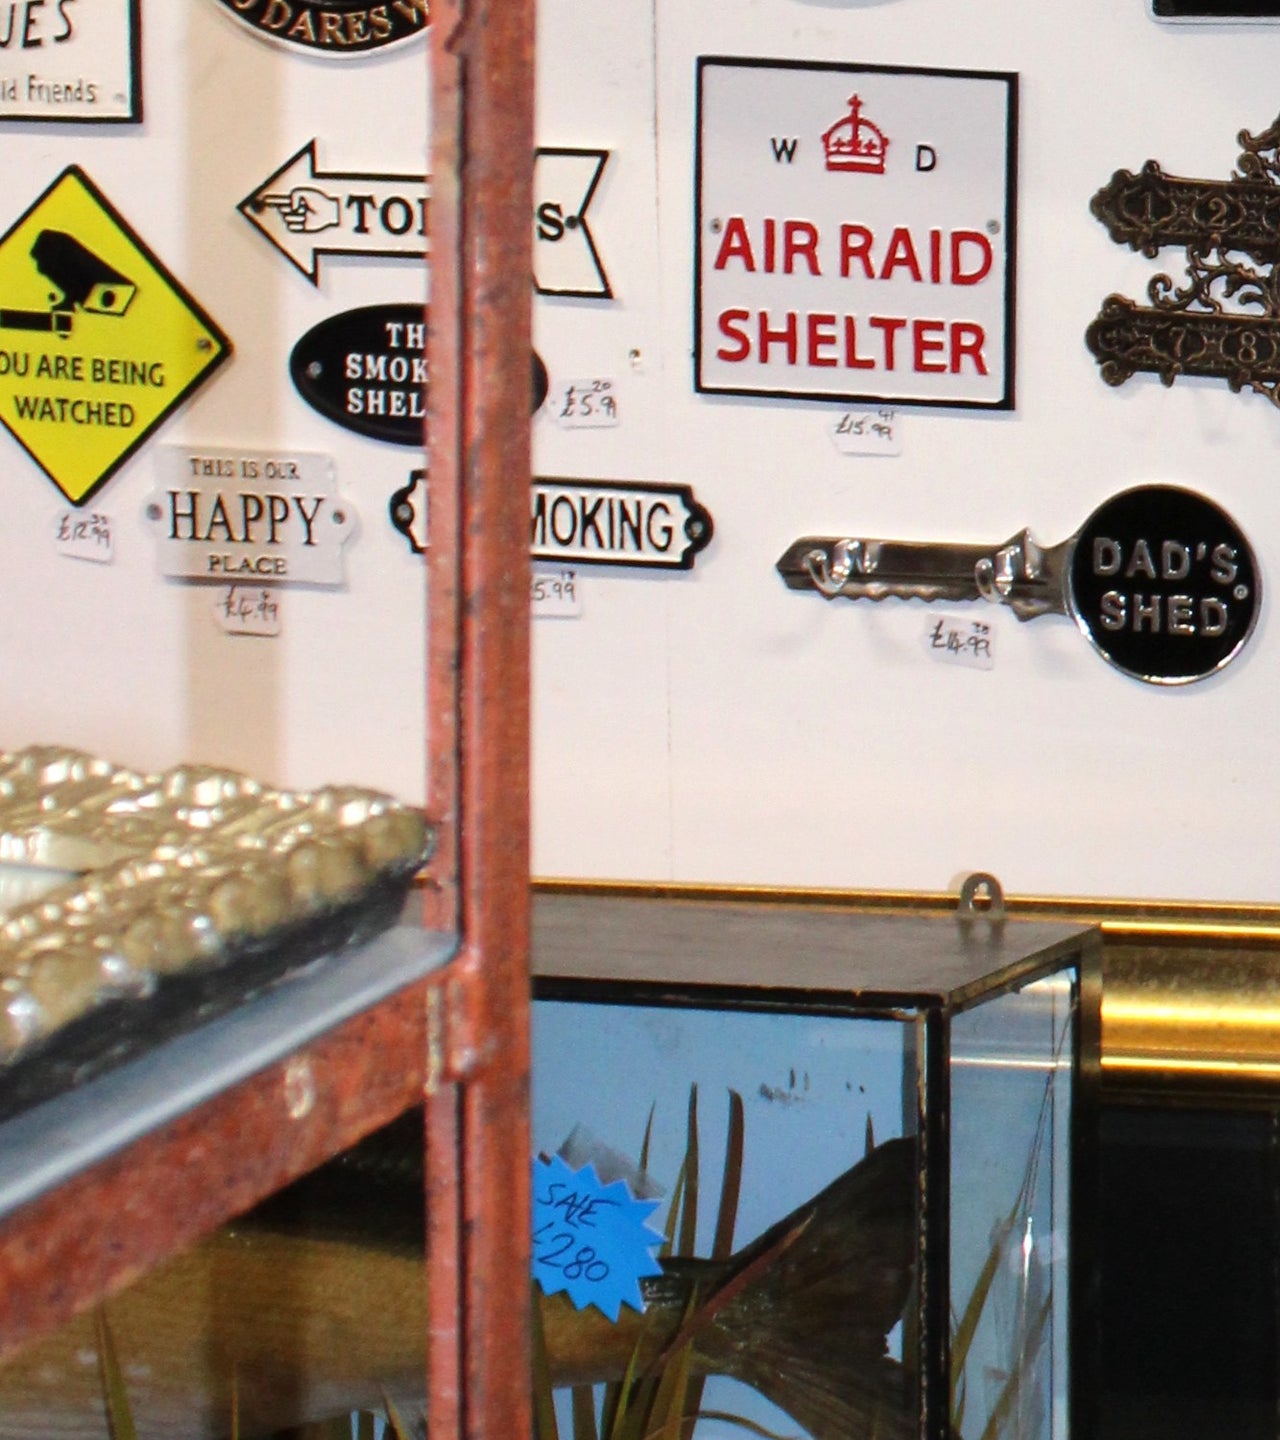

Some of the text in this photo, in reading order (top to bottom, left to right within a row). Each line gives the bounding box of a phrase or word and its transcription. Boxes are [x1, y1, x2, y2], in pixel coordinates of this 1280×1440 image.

[28, 74, 98, 103] Friends
[771, 137, 937, 172] W D
[1140, 189, 1156, 221] 1
[1208, 196, 1229, 227] 2
[714, 217, 994, 286] AIR RAID
[386, 323, 425, 348] TH
[716, 308, 989, 376] SHELTER
[1170, 328, 1188, 359] 7
[1237, 332, 1257, 363] 8
[37, 353, 83, 381] ARE
[92, 358, 165, 387] BEING
[345, 353, 428, 383] SMOK
[14, 396, 136, 427] WATCHED
[348, 388, 425, 417] SHEL
[835, 414, 892, 441] £15.99
[191, 457, 300, 480] THIS IS OUR
[168, 490, 324, 546] HAPPY
[532, 493, 674, 552] OKING
[207, 554, 288, 575] PLACE
[1092, 536, 1240, 585] DAD'S
[532, 582, 576, 604] 5.99
[1100, 589, 1229, 638] SHED
[537, 1183, 623, 1230] SALE
